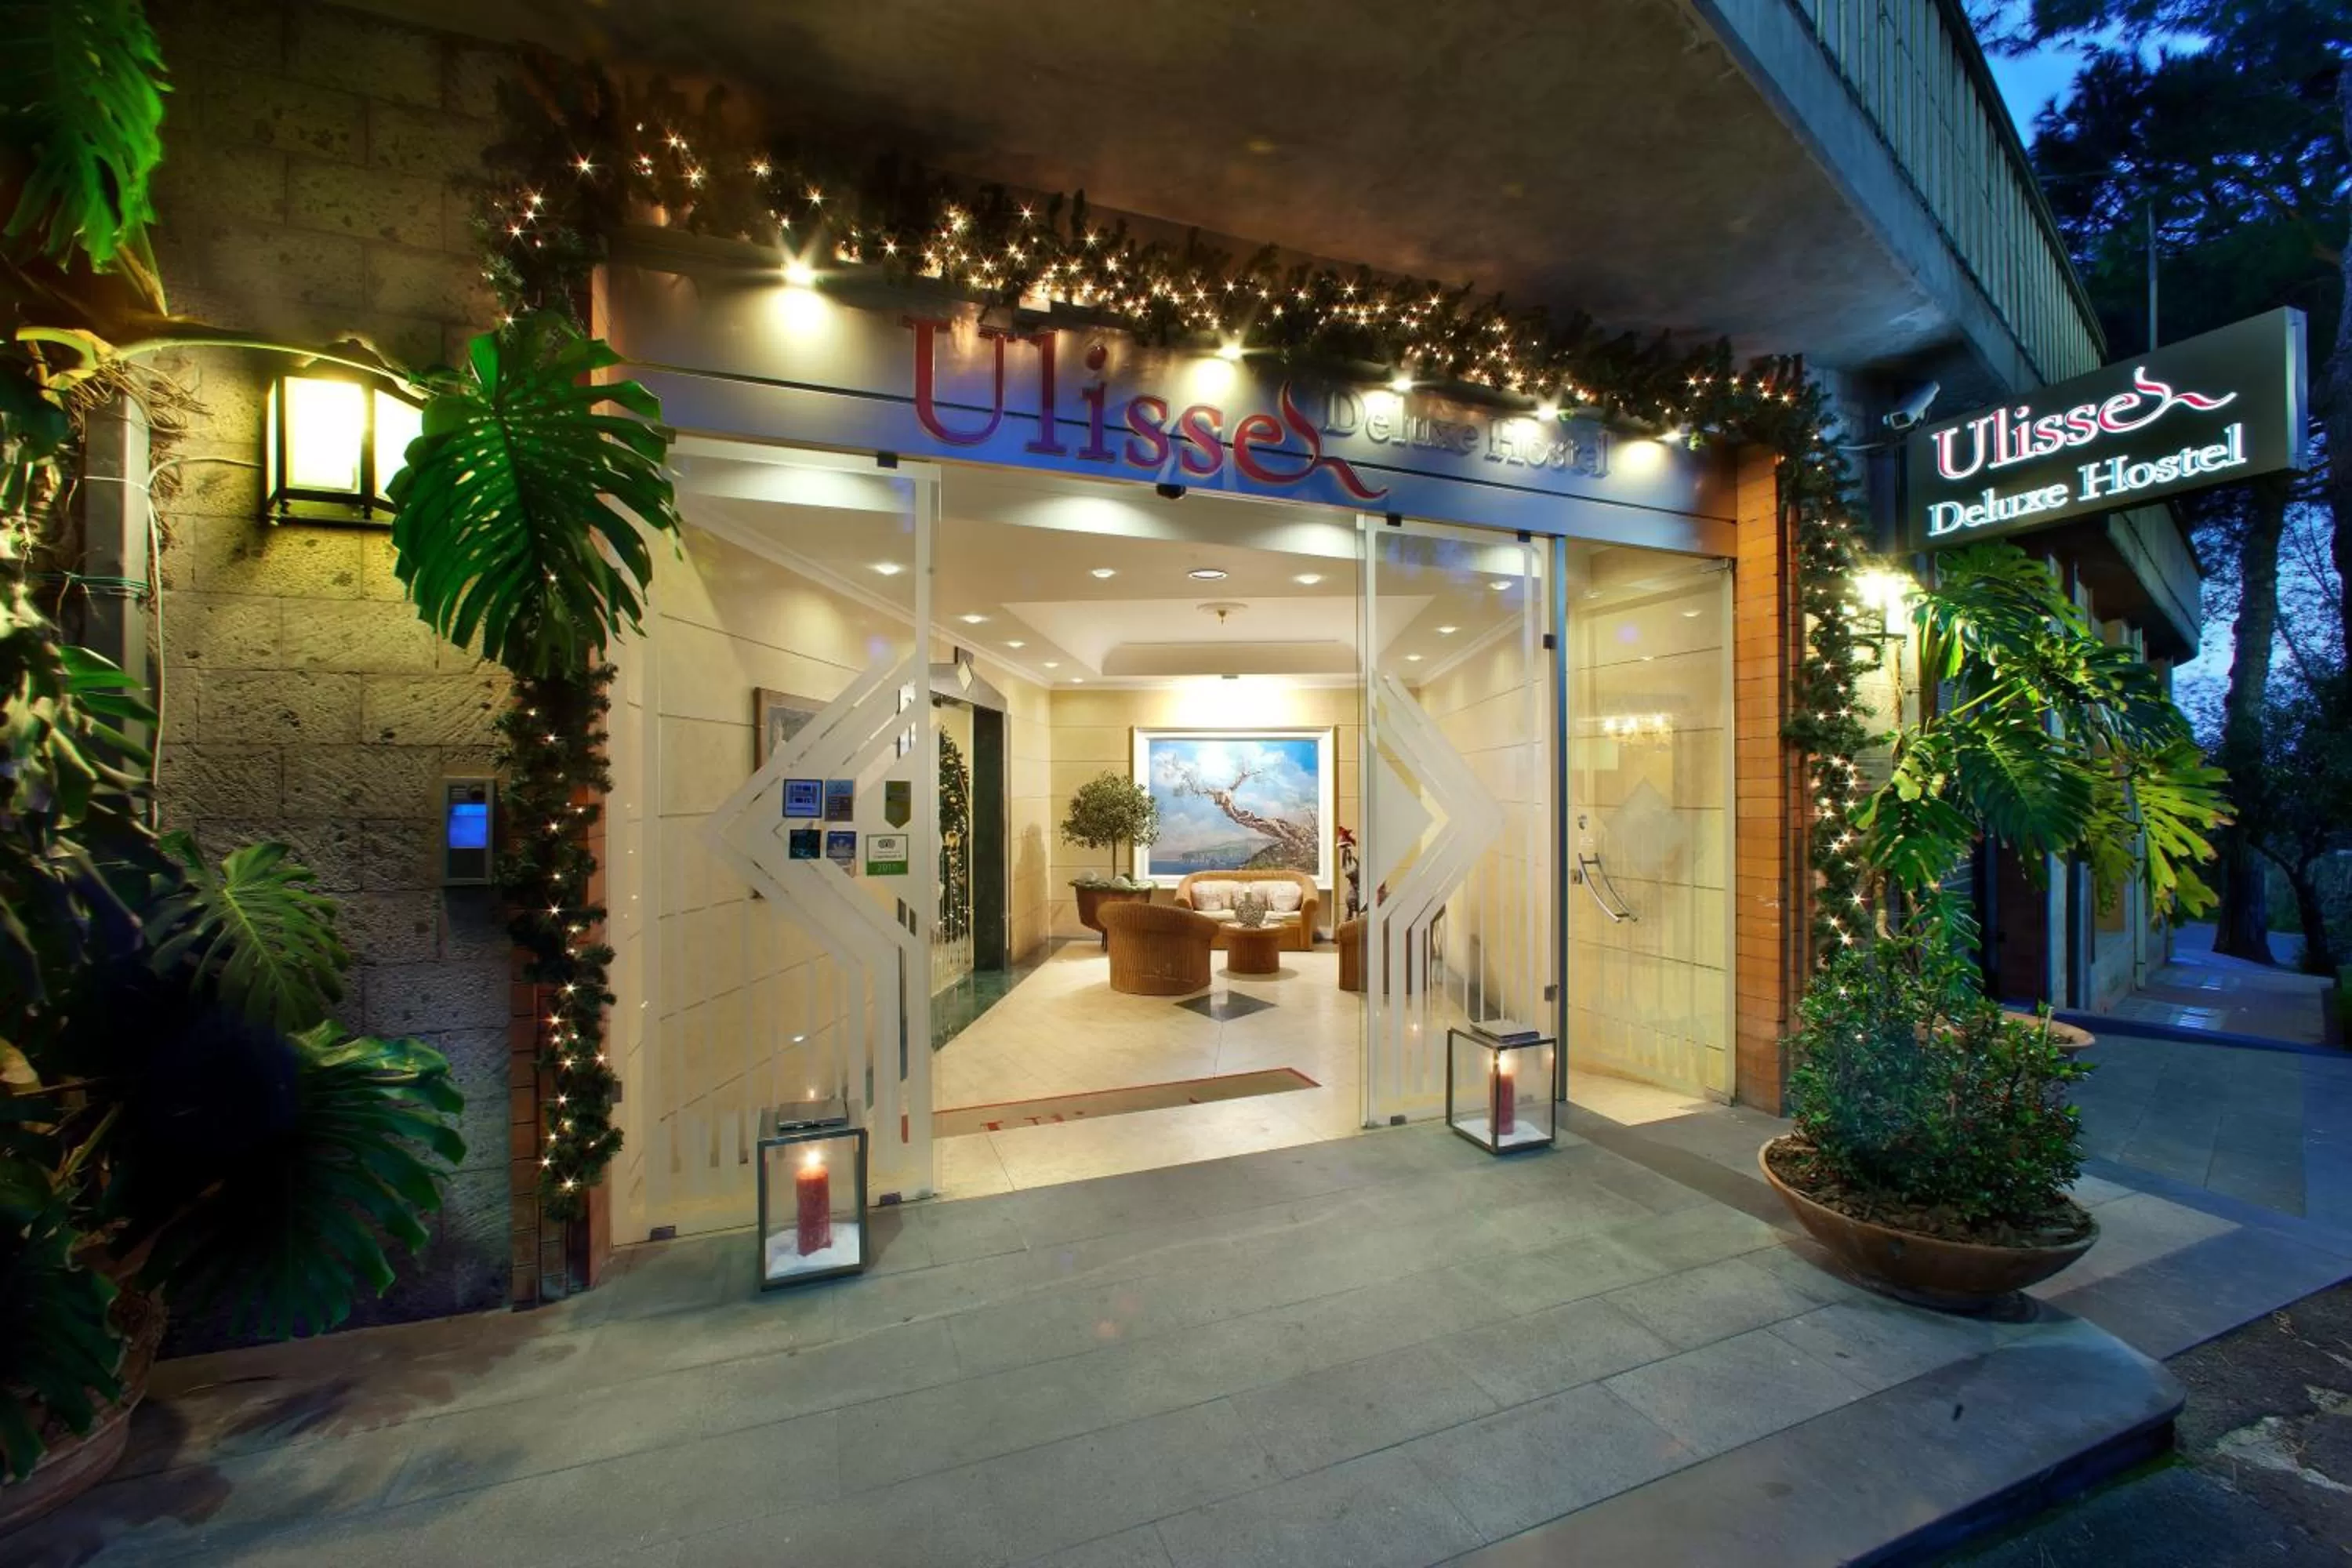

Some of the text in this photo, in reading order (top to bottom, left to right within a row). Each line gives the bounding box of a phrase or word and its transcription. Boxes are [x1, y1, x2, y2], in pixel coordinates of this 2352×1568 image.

[1324, 389, 1479, 456] Deluxe
[1484, 416, 1610, 478] Hostel
[1928, 423, 2247, 536] Deluxe Hostel
